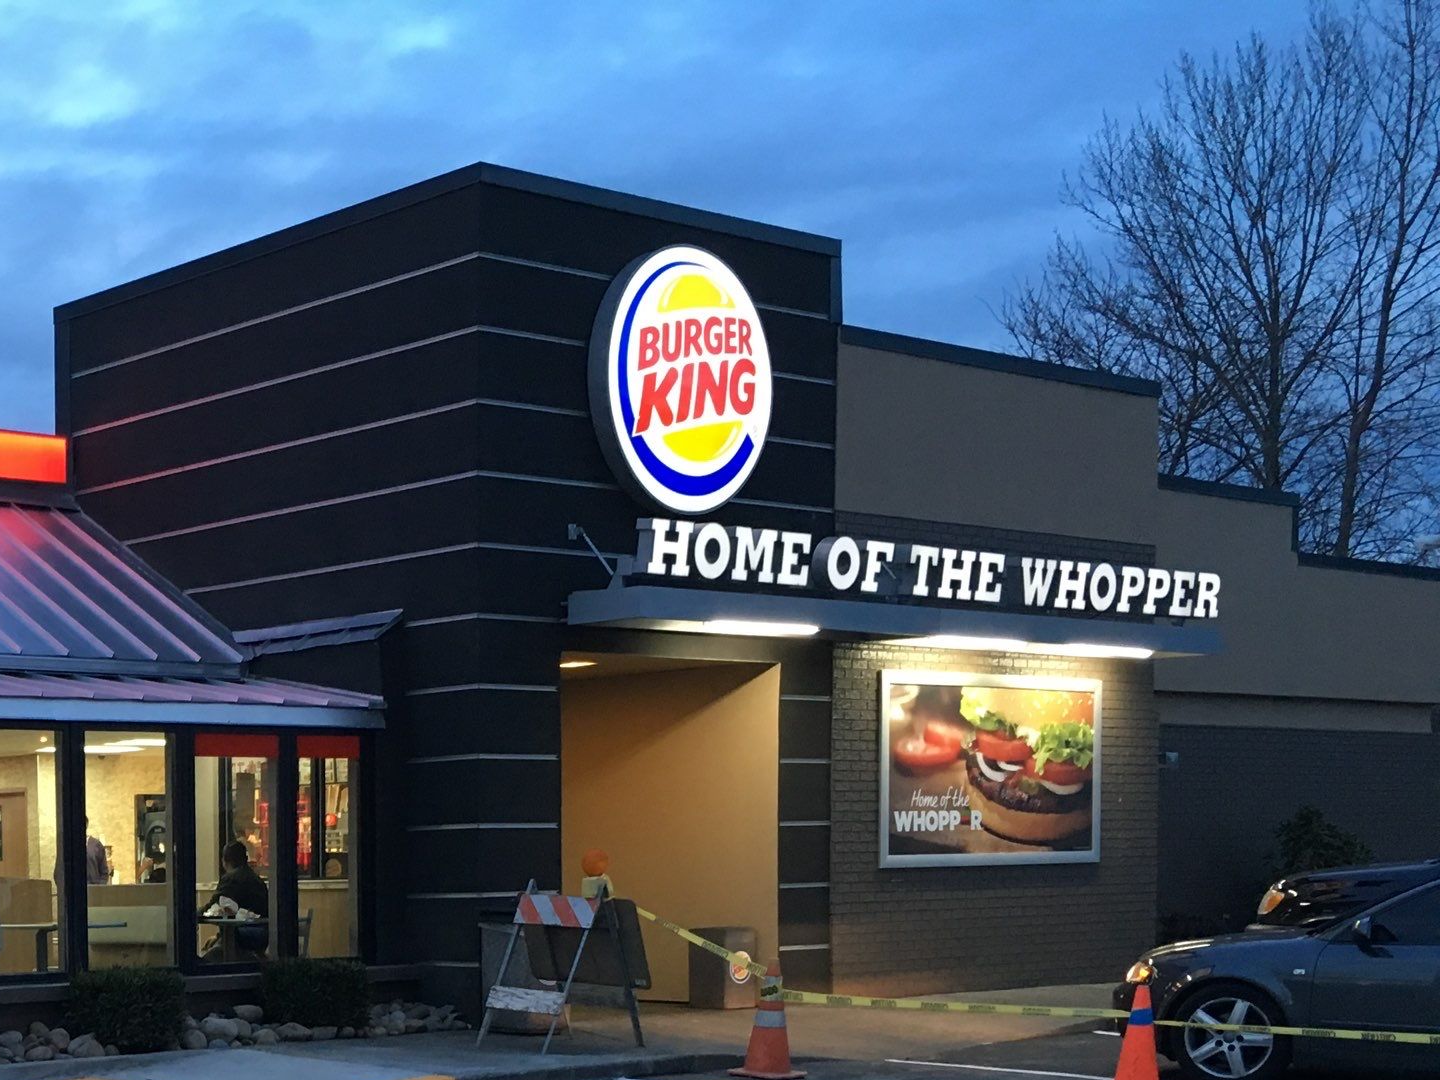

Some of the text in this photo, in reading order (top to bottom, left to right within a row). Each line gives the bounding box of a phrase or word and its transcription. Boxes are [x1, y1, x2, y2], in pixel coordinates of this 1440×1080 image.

[637, 316, 753, 371] BURGER
[634, 358, 756, 434] KING
[647, 517, 1222, 619] HOME OF THE WHOPPER
[893, 809, 983, 833] WHOPPR
[910, 784, 970, 812] Home of the
